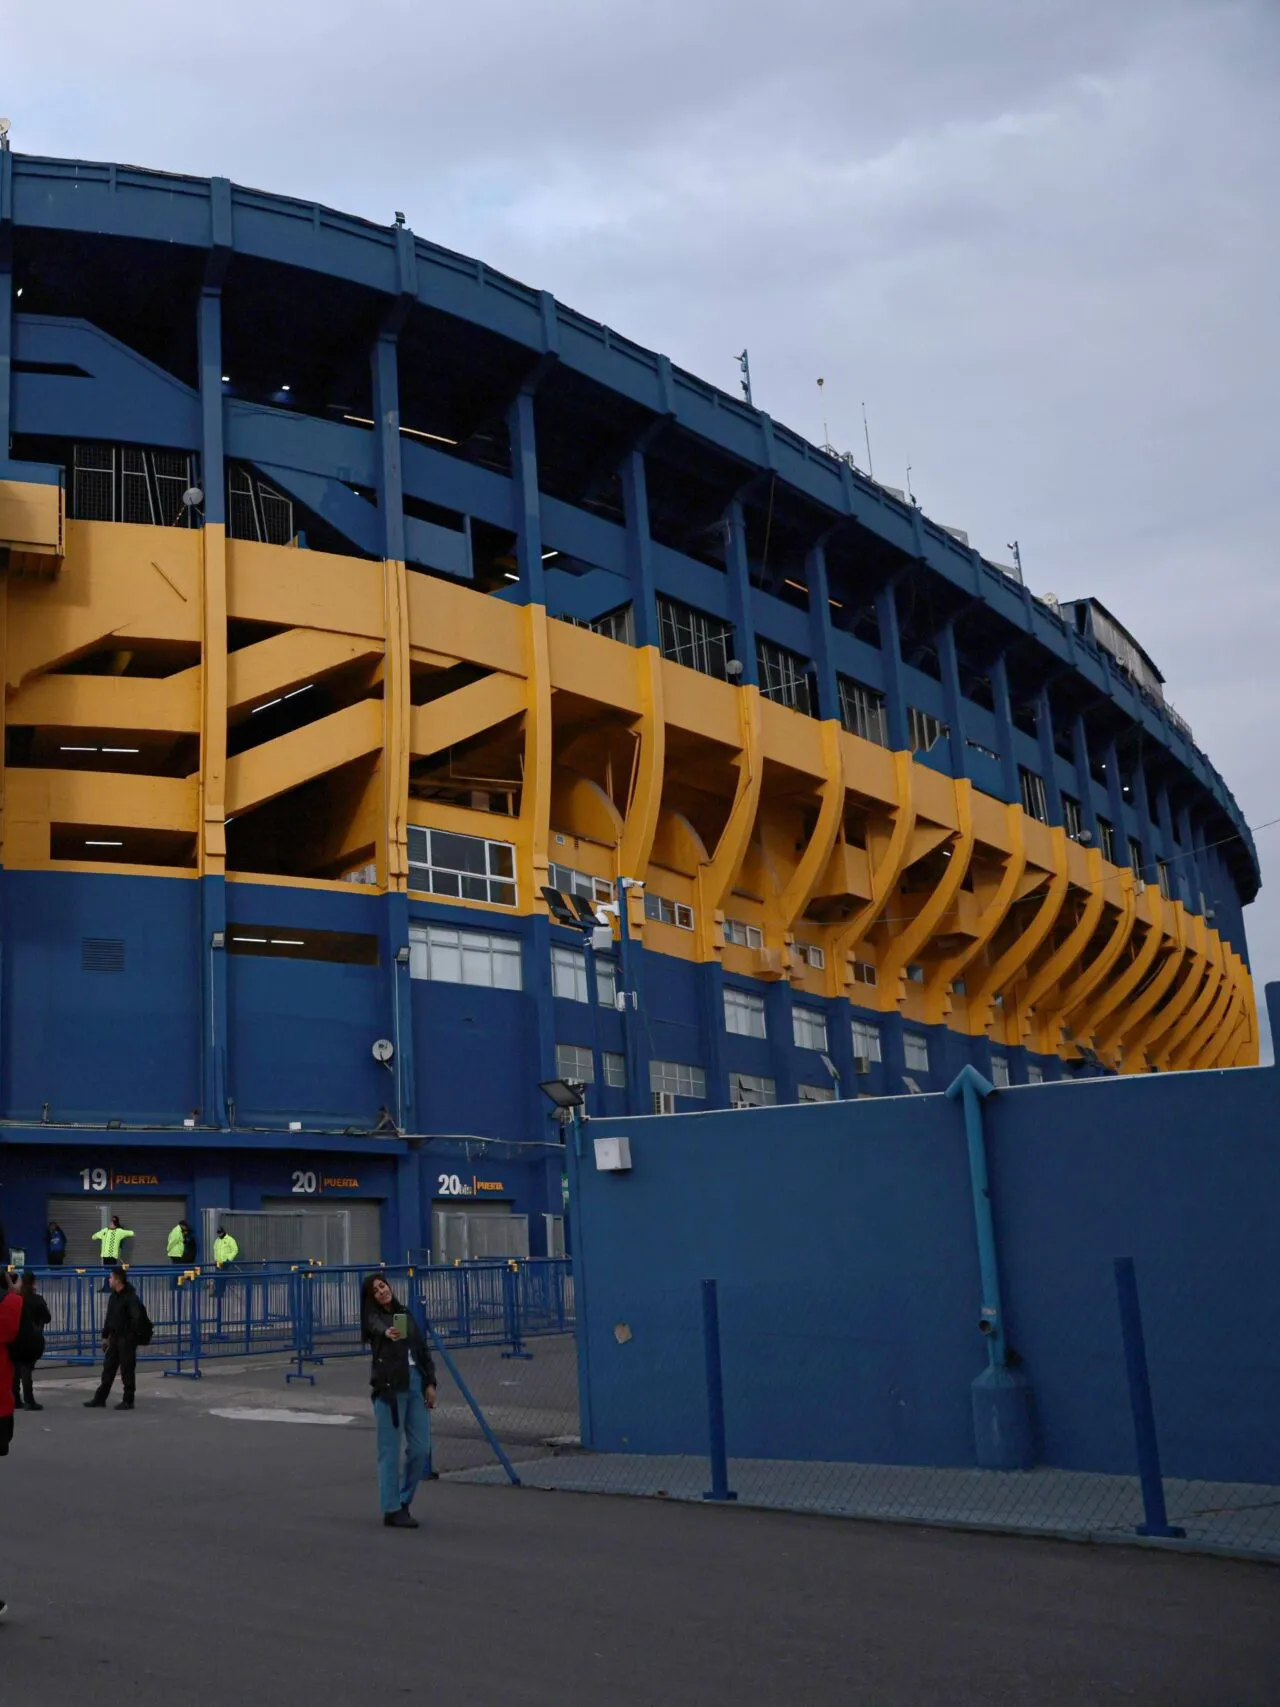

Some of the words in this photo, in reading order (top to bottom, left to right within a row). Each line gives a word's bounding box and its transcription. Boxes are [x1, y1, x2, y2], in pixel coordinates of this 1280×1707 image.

[80, 1168, 107, 1191] 19
[116, 1175, 158, 1184] PUERTA
[292, 1171, 317, 1193] 20
[323, 1178, 359, 1187] PUERTA
